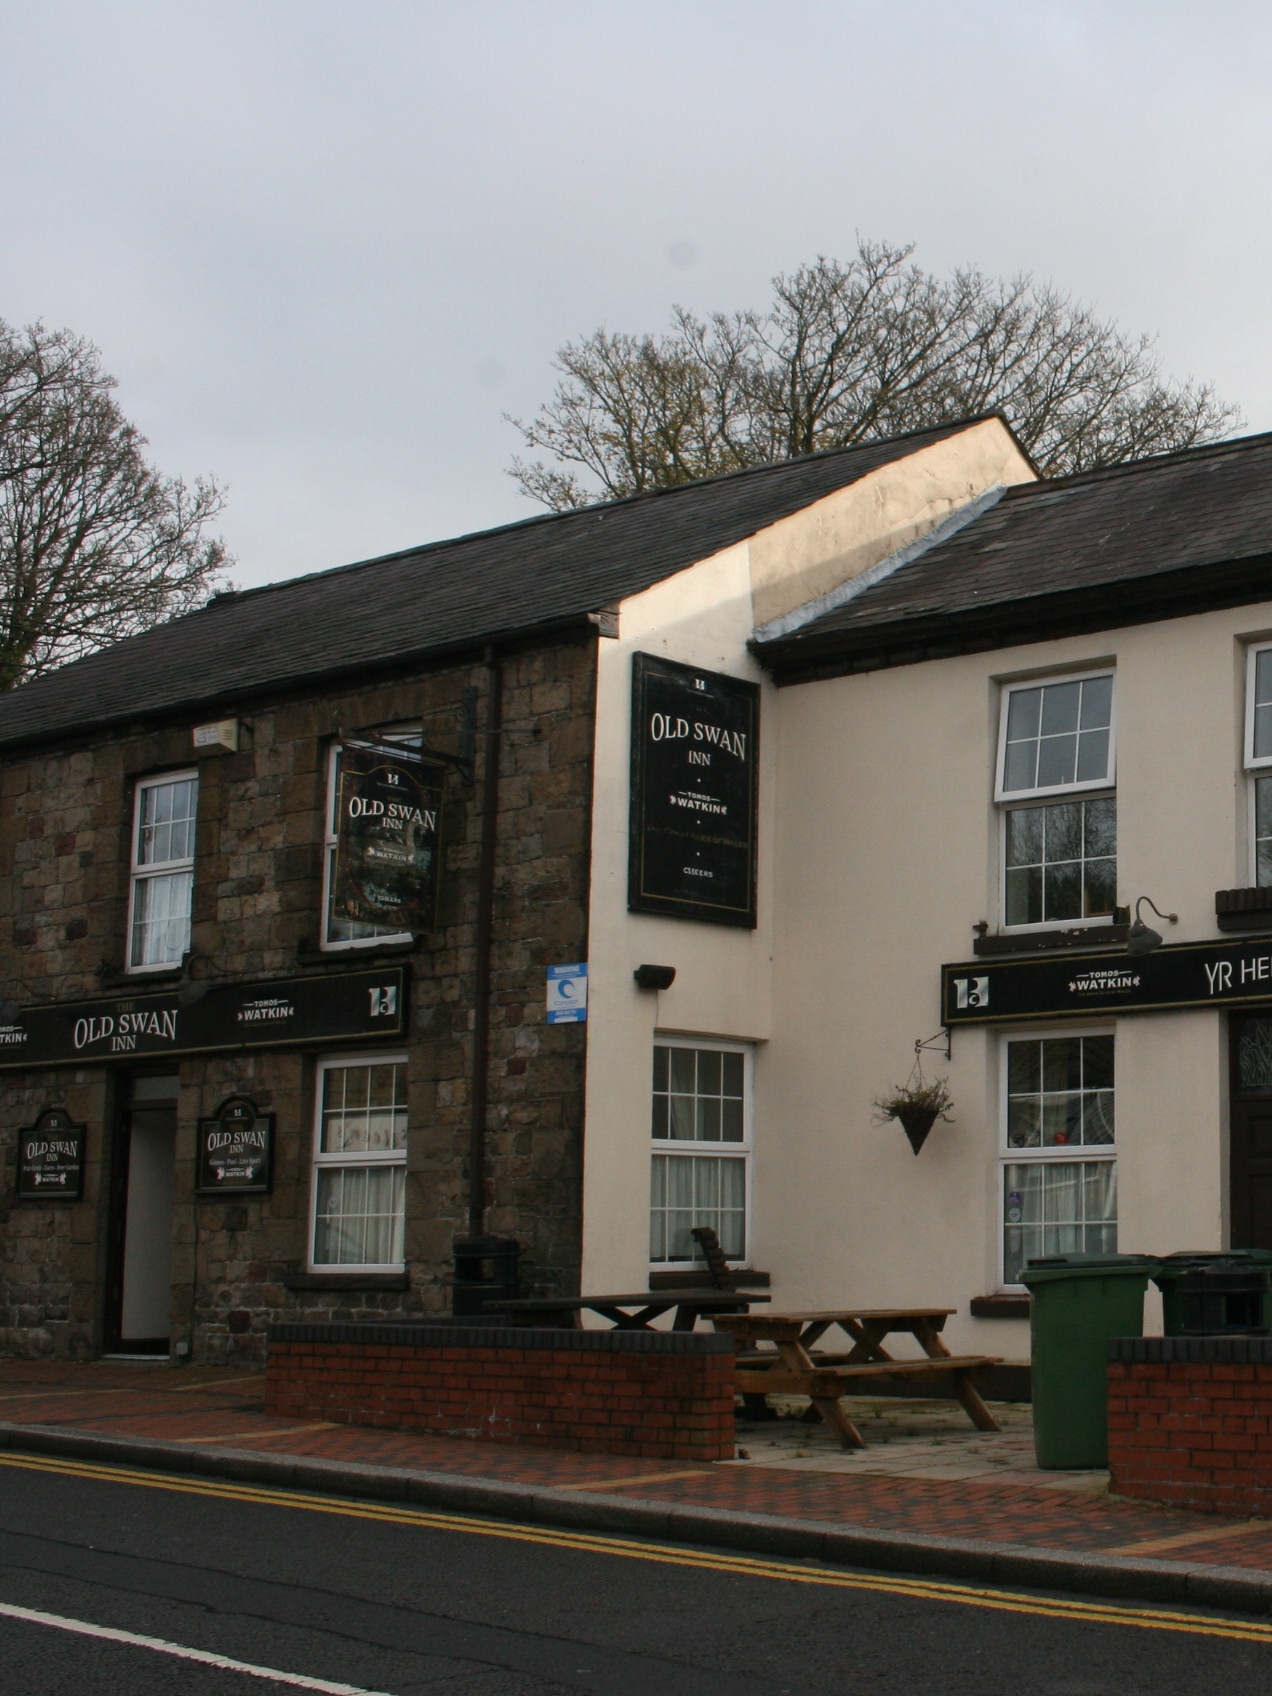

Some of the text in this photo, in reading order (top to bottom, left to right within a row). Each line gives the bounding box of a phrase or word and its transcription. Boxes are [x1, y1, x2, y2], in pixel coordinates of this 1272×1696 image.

[651, 712, 746, 761] OLD SWAN
[688, 750, 711, 766] INN
[677, 797, 720, 814] WATKIN
[349, 796, 437, 832] OLD SWAN
[382, 817, 404, 830] INN
[1089, 969, 1119, 979] TOMOS
[1204, 961, 1232, 995] YR
[1077, 976, 1132, 991] WATKIN
[254, 998, 278, 1007] TOMOS
[244, 1006, 289, 1021] WATKIN
[74, 1009, 178, 1049] OLD SWAN
[111, 1034, 137, 1052] INN
[207, 1130, 266, 1151] OLD SWAN
[27, 1140, 78, 1160] OLD SWAN
[229, 1144, 244, 1154] INN
[46, 1153, 59, 1162] INN
